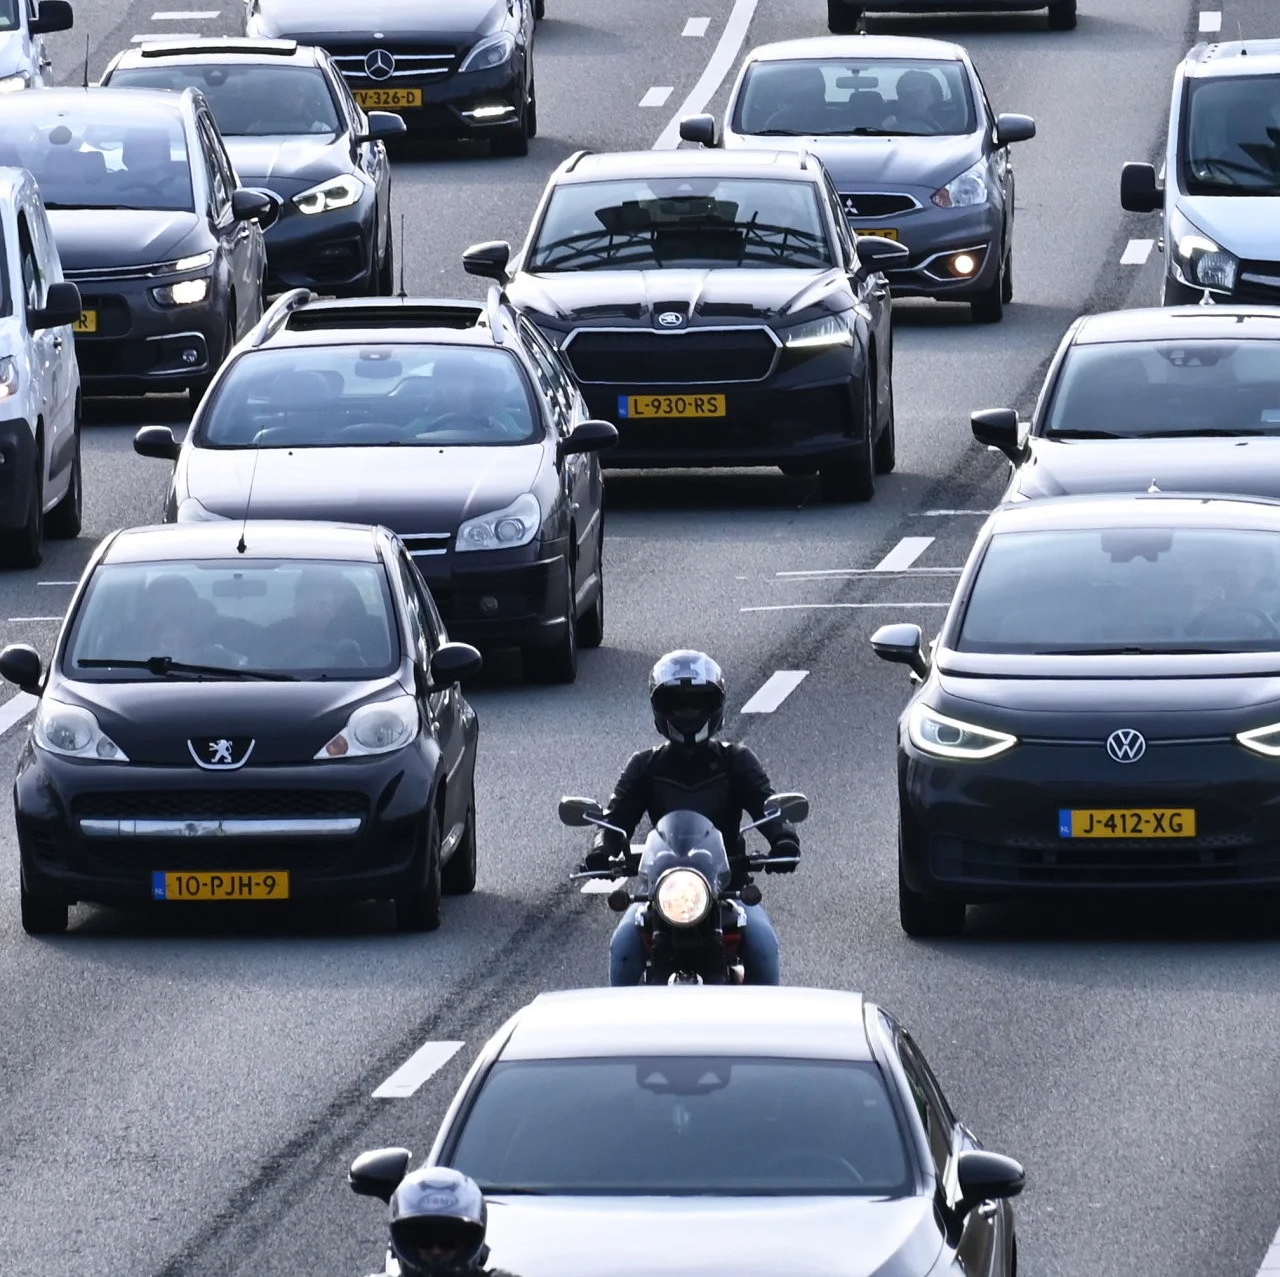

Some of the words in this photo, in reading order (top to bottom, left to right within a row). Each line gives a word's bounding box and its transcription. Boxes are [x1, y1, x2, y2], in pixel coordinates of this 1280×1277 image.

[633, 396, 719, 415] L-930-RS
[1083, 812, 1184, 834] J-412-XG
[175, 875, 278, 896] 10-PJH-9
